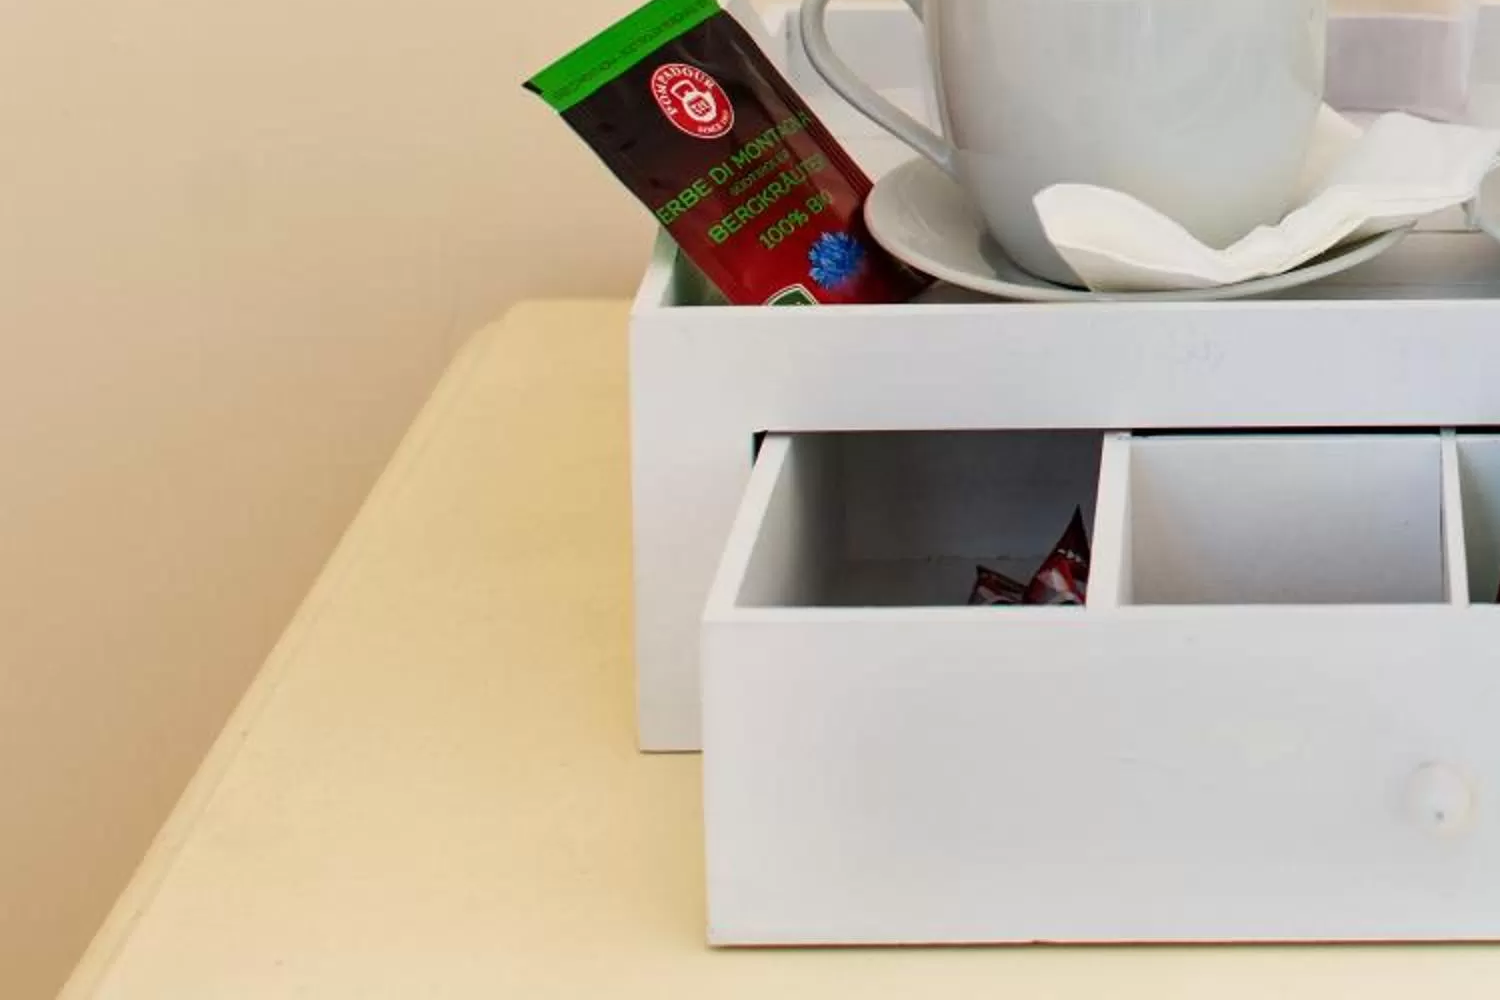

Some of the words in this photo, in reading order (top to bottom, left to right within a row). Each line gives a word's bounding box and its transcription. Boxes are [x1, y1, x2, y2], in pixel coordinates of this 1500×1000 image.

[656, 67, 714, 115] POMPADOUR
[656, 178, 714, 225] ERBE
[708, 162, 734, 185] DI
[760, 210, 809, 249] 100%
